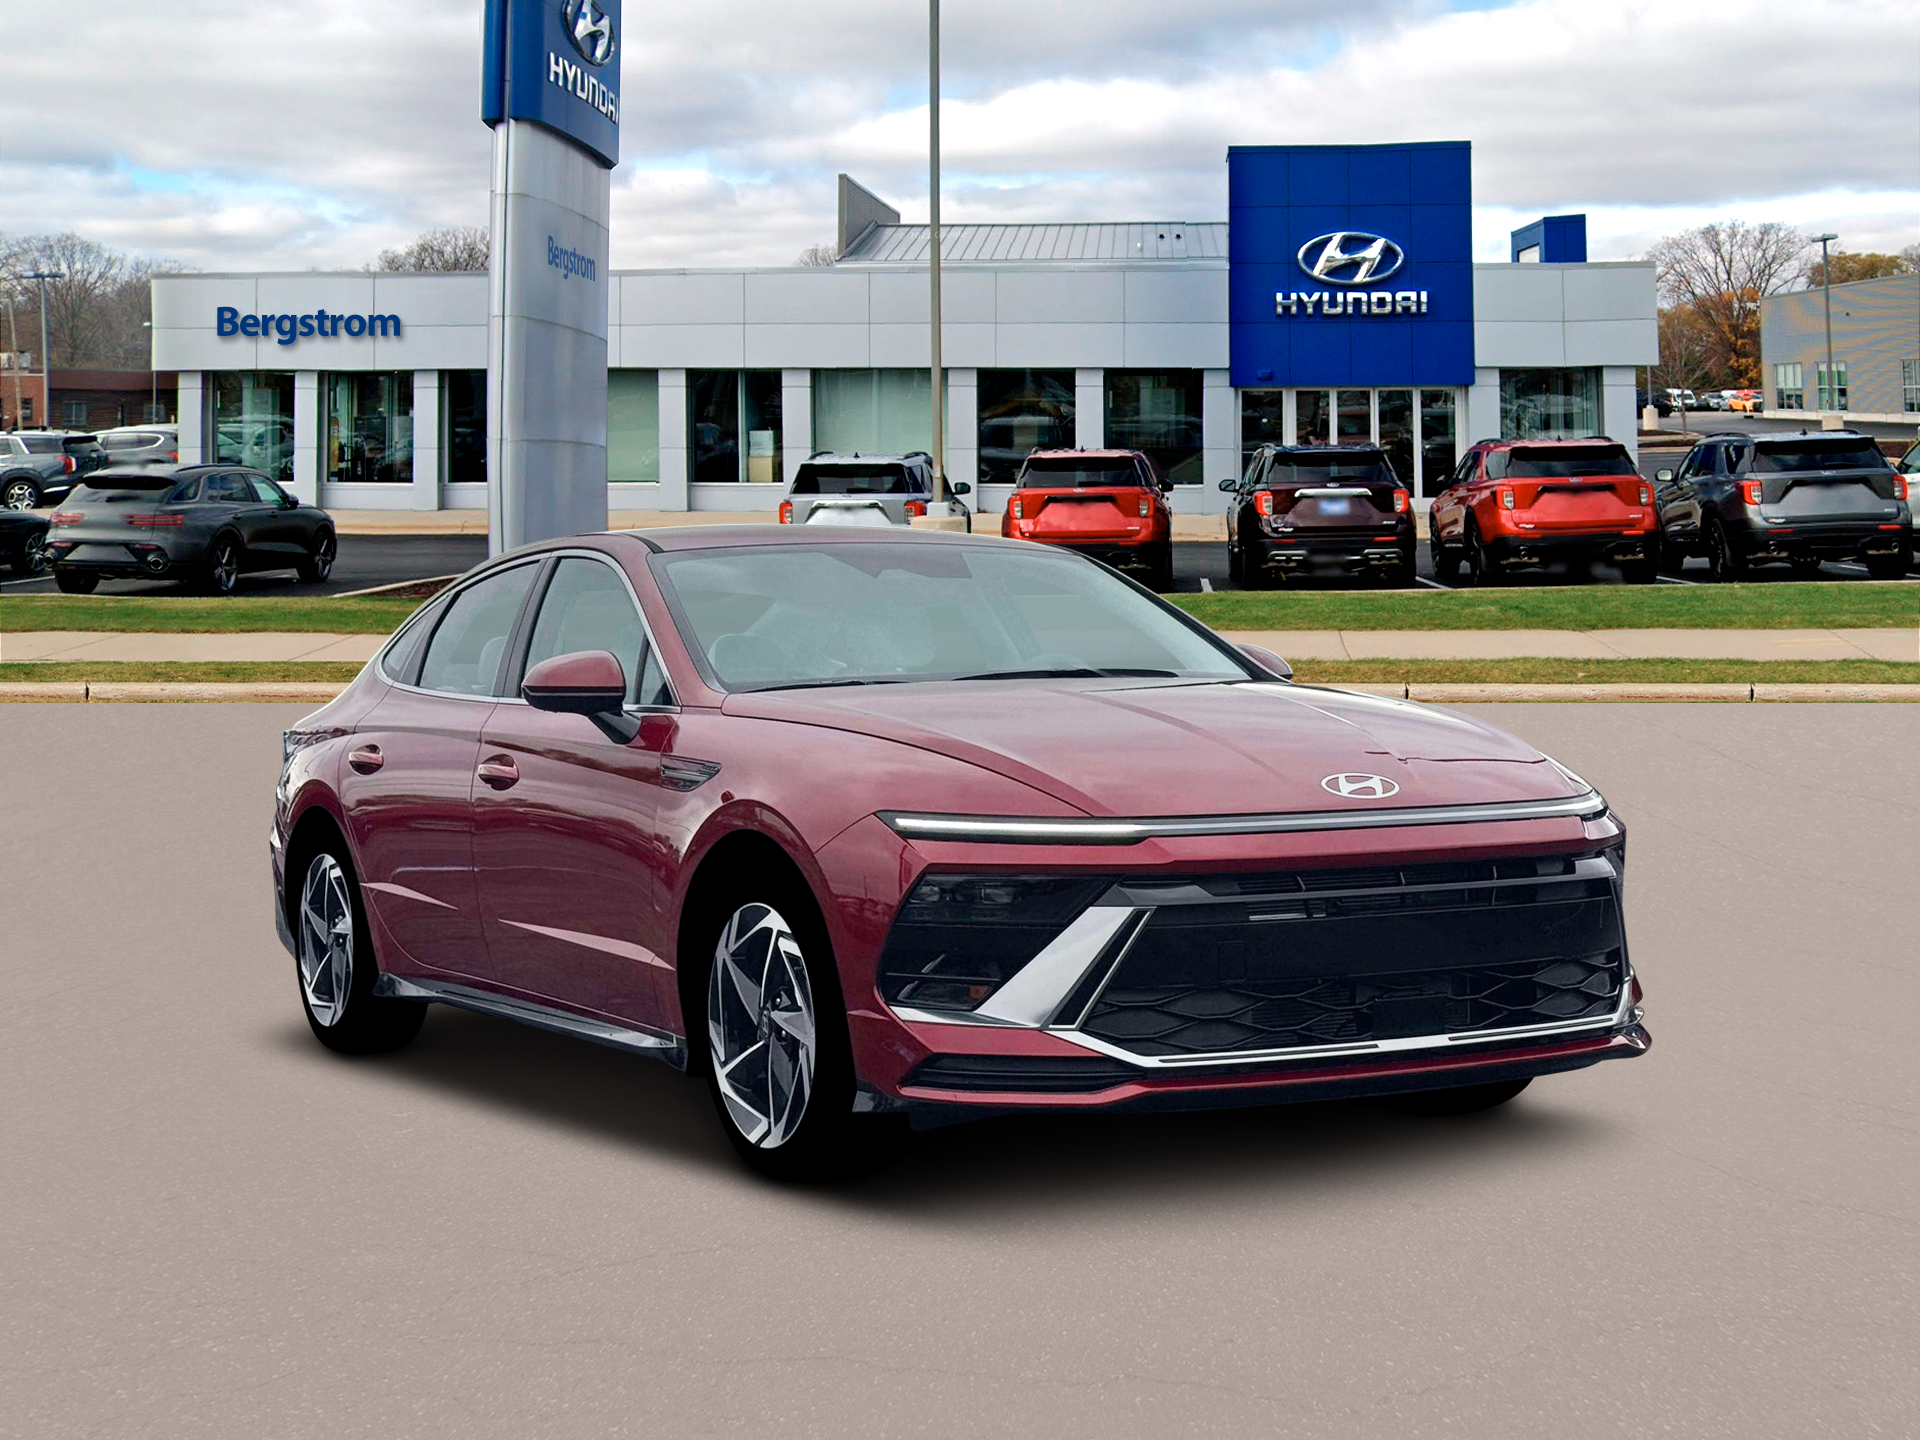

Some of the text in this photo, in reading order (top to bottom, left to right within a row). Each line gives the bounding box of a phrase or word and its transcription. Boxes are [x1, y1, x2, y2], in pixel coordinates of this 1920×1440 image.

[549, 52, 619, 124] HYUNDAI
[547, 235, 596, 281] Bergstrom
[1275, 290, 1429, 316] HYUNDAI
[216, 307, 401, 345] Bergstrom
